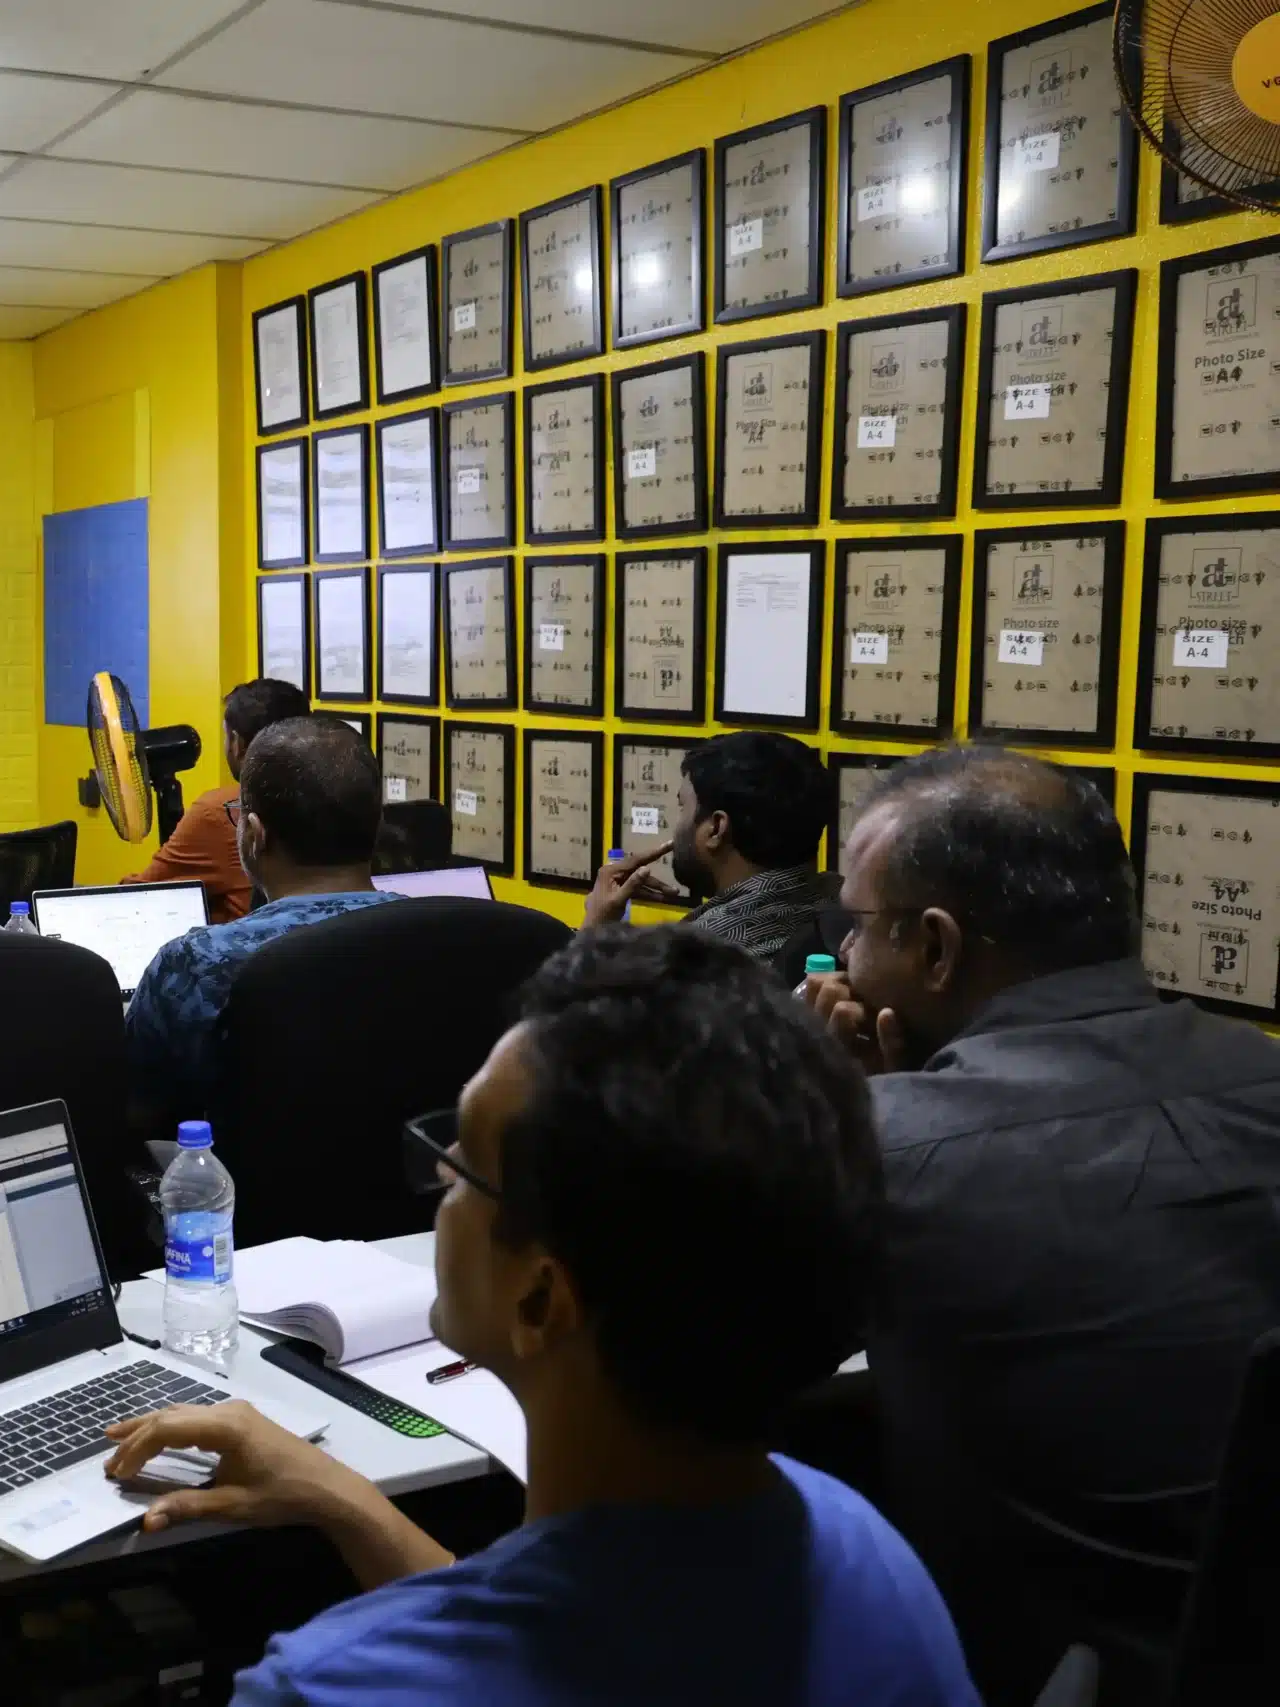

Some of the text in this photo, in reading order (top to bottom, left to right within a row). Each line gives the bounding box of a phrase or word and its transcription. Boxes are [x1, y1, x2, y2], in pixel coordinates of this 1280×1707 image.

[1194, 348, 1266, 369] Photo Size
[1016, 400, 1035, 411] A-4
[867, 430, 883, 441] A-4
[1003, 615, 1060, 629] Photo size
[1178, 615, 1248, 630] Photo size
[1182, 635, 1215, 644] SIZE
[859, 646, 876, 656] A-4
[1009, 645, 1028, 656] A-4
[1186, 647, 1209, 658] A-4
[1213, 886, 1241, 903] A4
[1191, 900, 1262, 921] Photo Size
